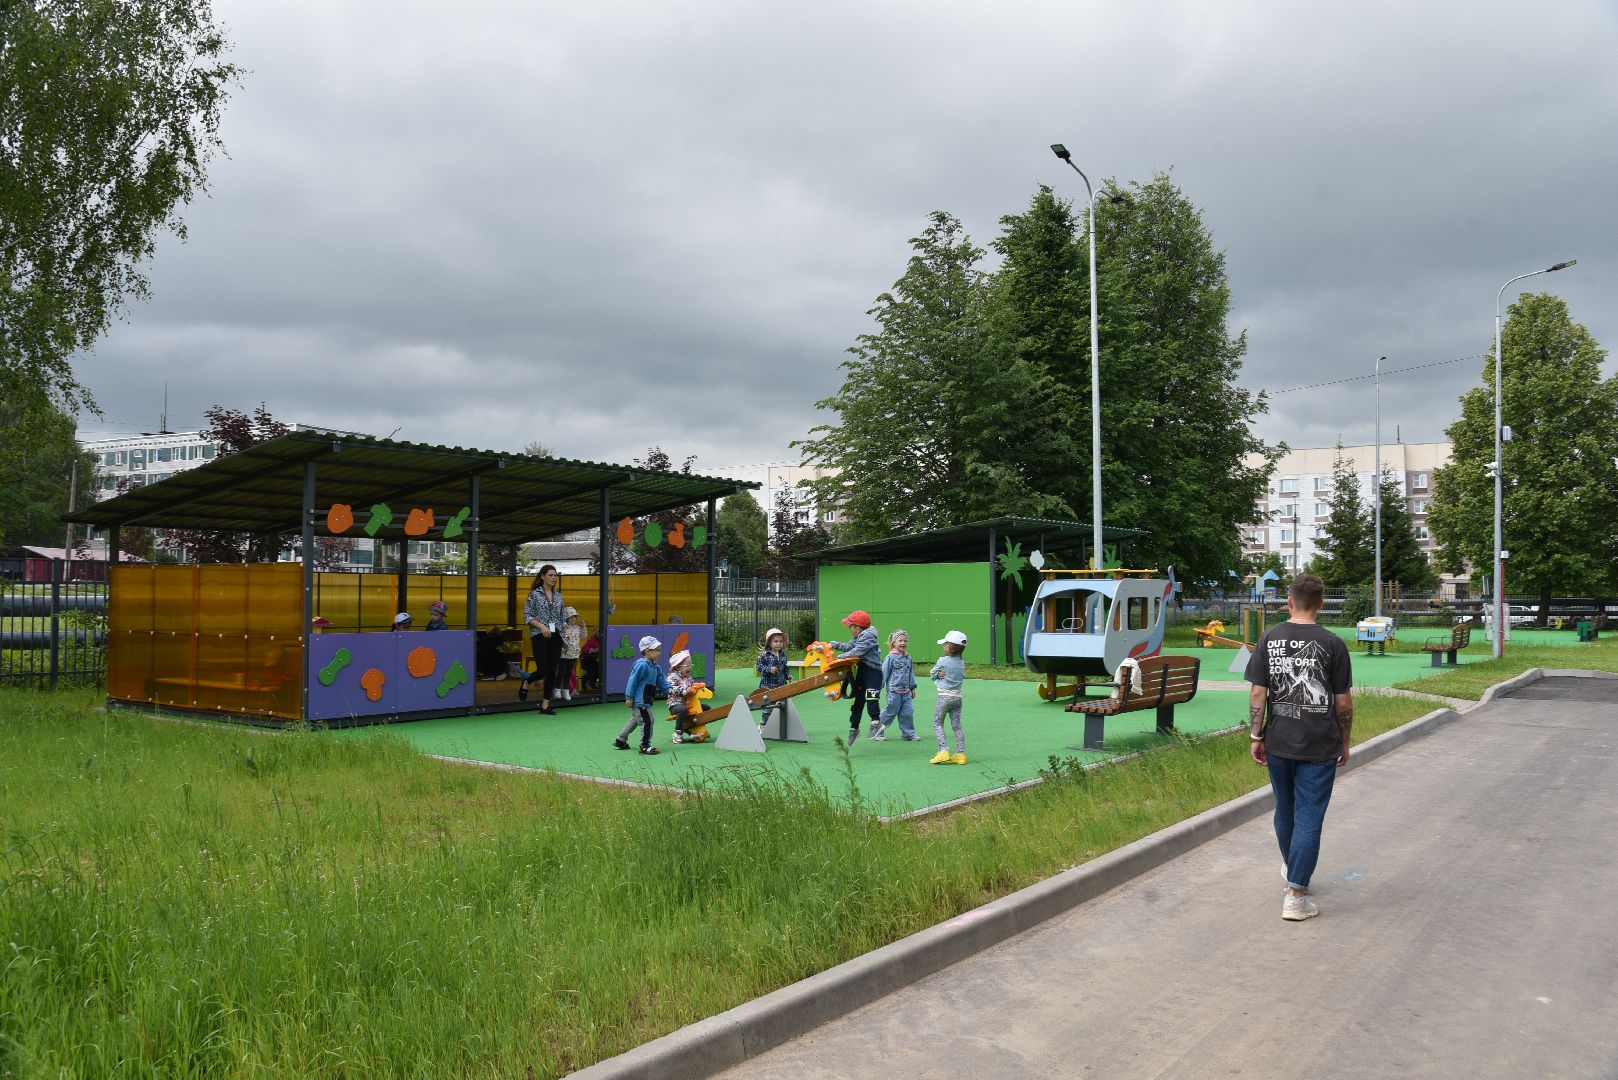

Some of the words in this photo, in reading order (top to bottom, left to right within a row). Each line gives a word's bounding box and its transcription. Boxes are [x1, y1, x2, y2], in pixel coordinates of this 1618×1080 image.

[1267, 640, 1287, 648] OUT
[1290, 640, 1305, 648] OF
[1267, 648, 1286, 656] THE
[1269, 657, 1316, 667] COMFORT
[1269, 666, 1293, 674] ZONE
